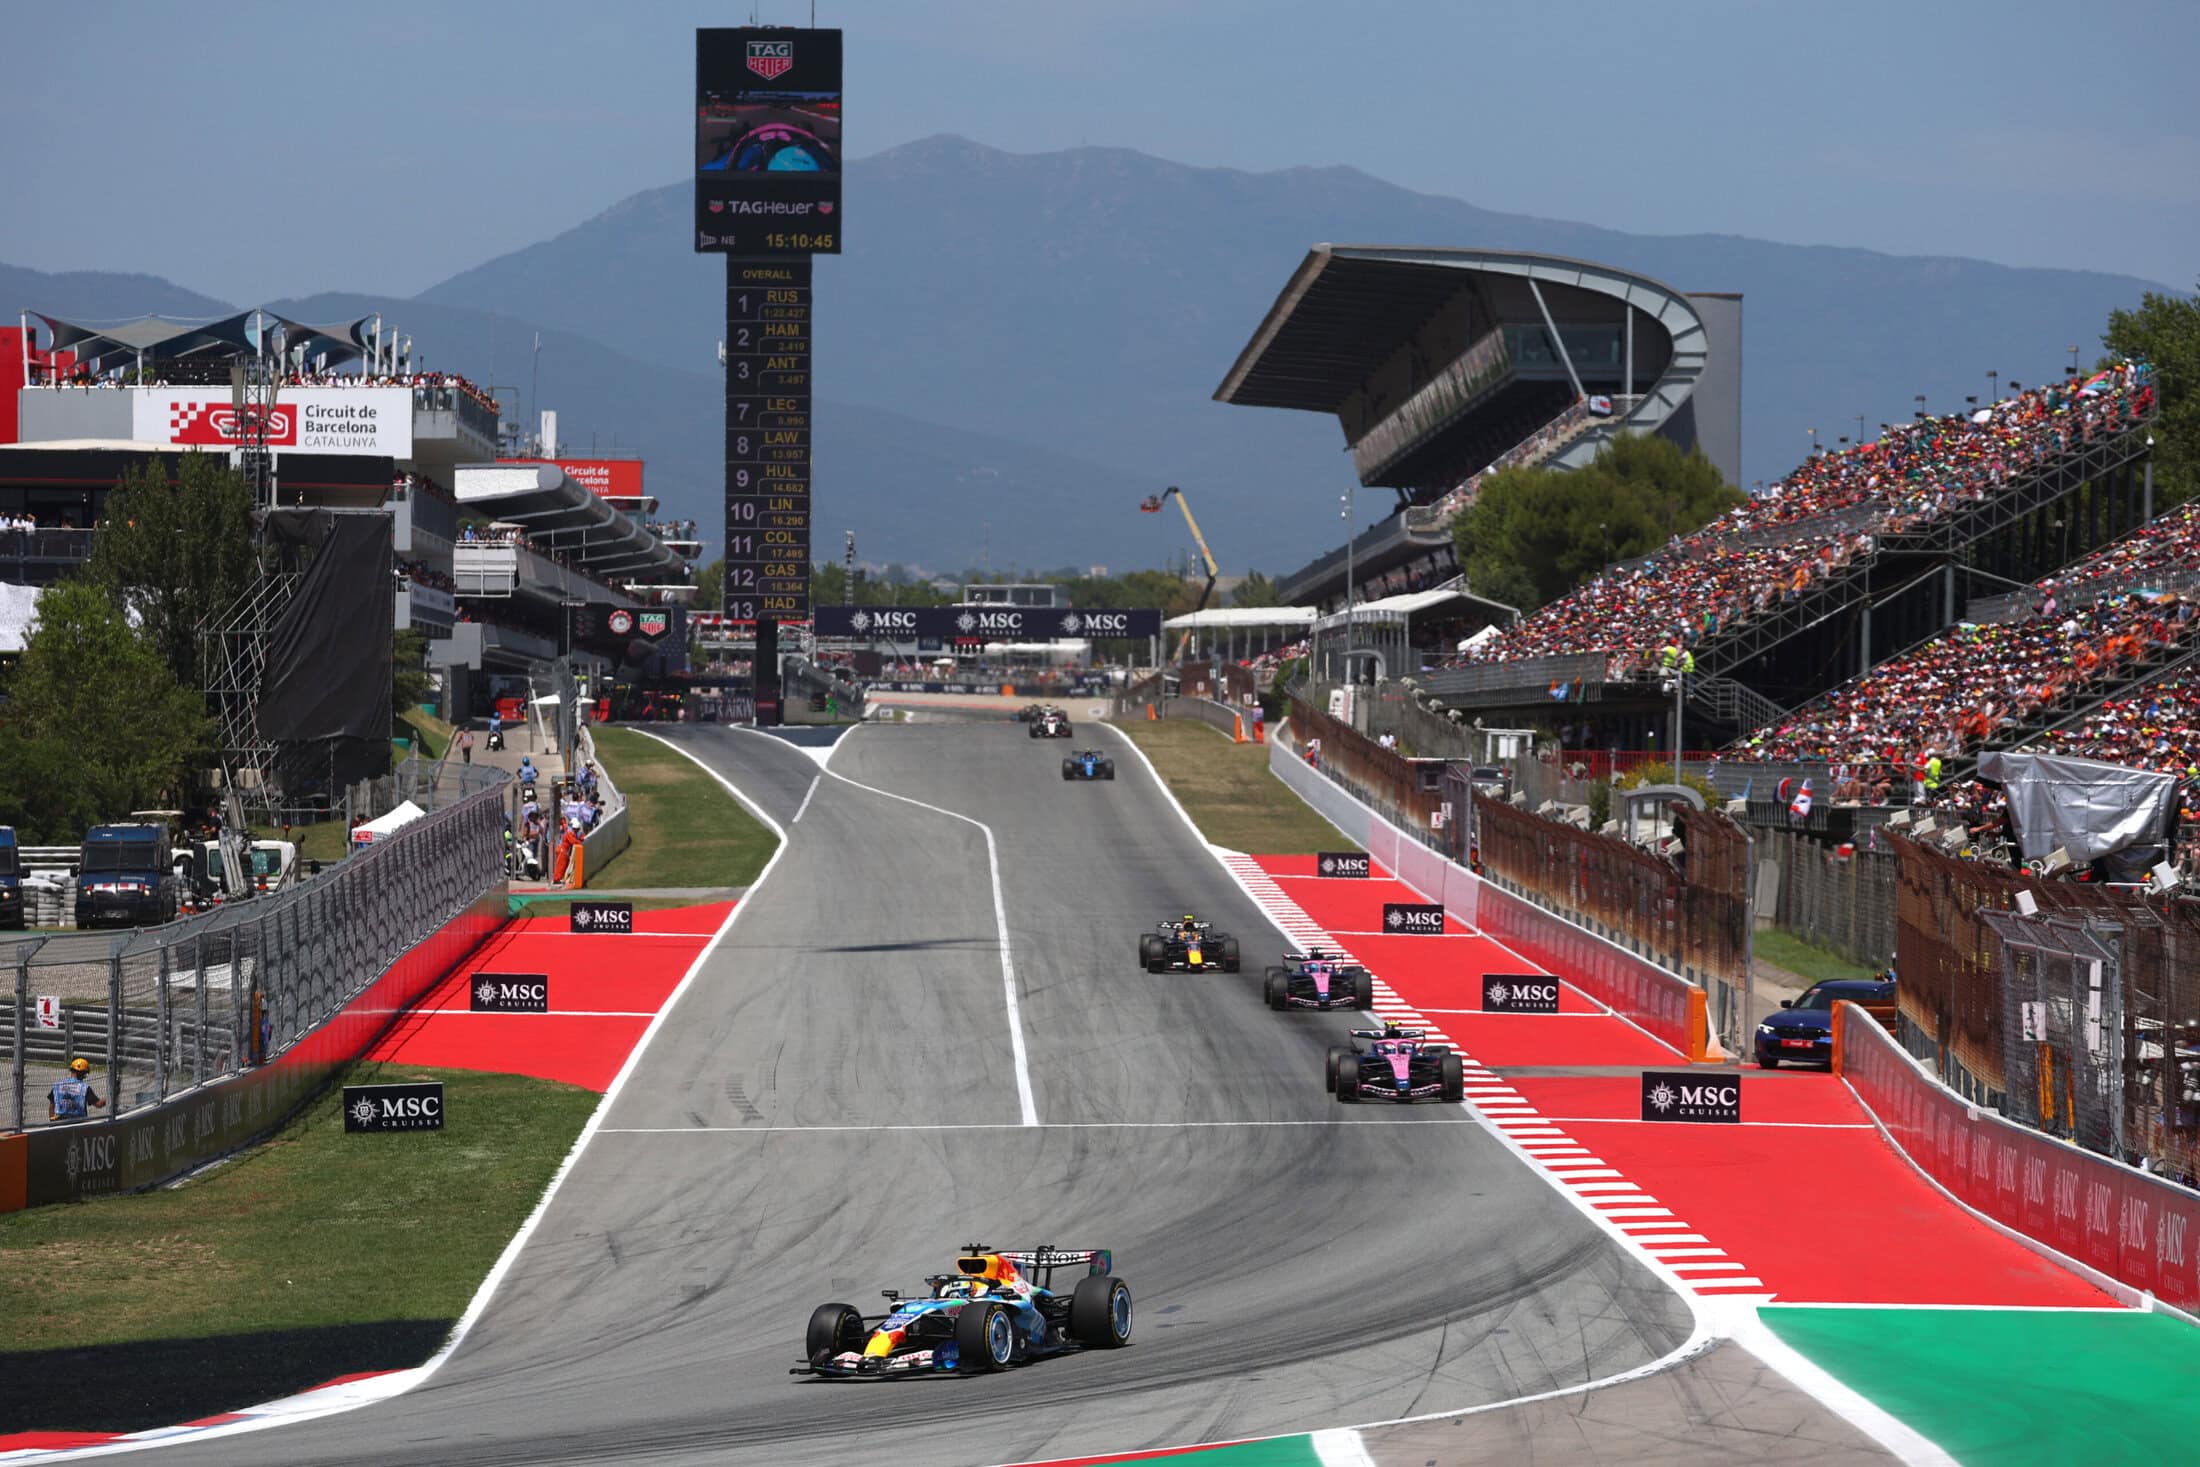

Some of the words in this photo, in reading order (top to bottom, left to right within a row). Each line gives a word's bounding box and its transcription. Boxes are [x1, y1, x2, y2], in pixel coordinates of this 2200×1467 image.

[751, 44, 788, 56] TAG
[749, 57, 789, 77] HEUER
[766, 233, 833, 249] 15:10:45
[742, 270, 793, 280] OVERALL
[738, 294, 747, 313] 1
[767, 290, 799, 303] RUS
[737, 328, 750, 346] 2
[765, 324, 800, 336] HAM
[737, 361, 750, 379] 3
[766, 357, 798, 369] ANT
[305, 404, 355, 419] Circuit
[358, 404, 377, 419] de
[737, 403, 749, 421] 7
[767, 399, 797, 411] LEC
[305, 420, 377, 434] Barcelona
[304, 436, 377, 448] CATALUNYA
[737, 436, 749, 454] 8
[764, 432, 798, 444] LAW
[564, 466, 596, 476] Circuit
[597, 466, 610, 476] de
[736, 469, 749, 487] 9
[766, 465, 795, 477] HUL
[576, 476, 610, 485] rcelona
[731, 502, 755, 521] 10
[769, 499, 793, 510] LIN
[731, 535, 752, 554] 11
[765, 531, 796, 544] COL
[730, 568, 754, 587] 12
[764, 564, 796, 576] GAS
[730, 601, 754, 619] 13
[764, 597, 796, 609] HAD
[873, 612, 917, 627] MSC
[979, 613, 1022, 628] MSC
[1085, 614, 1127, 630] MSC
[1337, 859, 1368, 870] MSC
[594, 910, 630, 923] MSC
[1406, 912, 1442, 925] MSC
[500, 983, 545, 1000] MSC
[1512, 984, 1557, 1001] MSC
[1680, 1086, 1737, 1106] MSC
[381, 1096, 440, 1118] MSC
[1679, 1108, 1737, 1116] CRUISES
[382, 1119, 440, 1127] CRUISES
[83, 1133, 116, 1172] MSC
[2030, 1155, 2047, 1206] MSC
[2060, 1169, 2080, 1221] MSC
[2093, 1182, 2113, 1236] MSC
[2128, 1196, 2149, 1251] MSC
[2165, 1211, 2188, 1268] MSC
